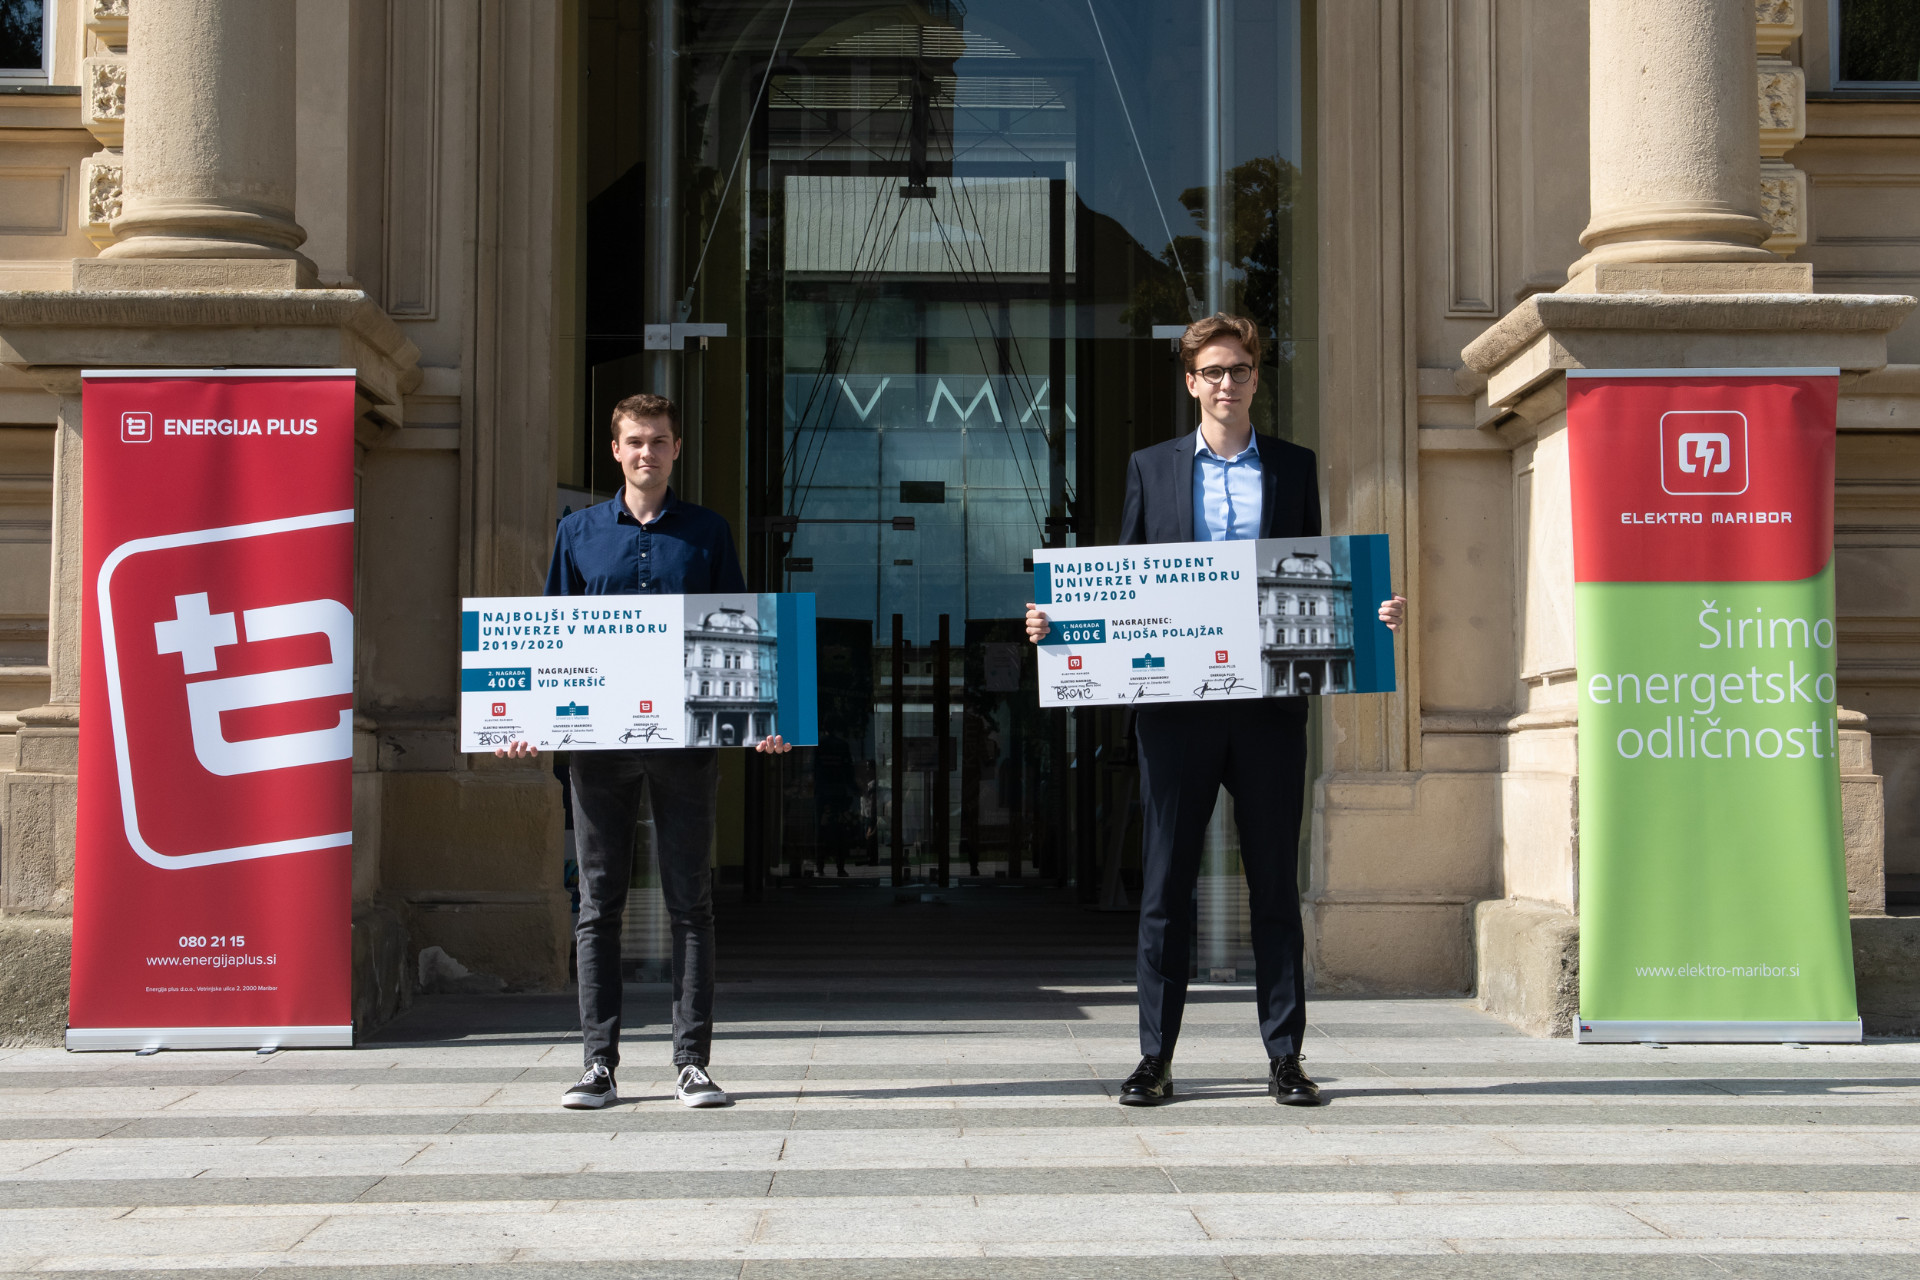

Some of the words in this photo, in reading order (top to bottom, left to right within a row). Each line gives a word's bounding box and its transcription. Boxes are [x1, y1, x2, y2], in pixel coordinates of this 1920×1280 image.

[164, 418, 262, 436] ENERGIJA
[267, 418, 318, 435] PLUS
[1621, 512, 1703, 524] ELEKTRO
[1711, 511, 1793, 524] MARIBOR
[1054, 558, 1136, 575] NAJBOLJŠI
[1143, 556, 1215, 570] ŠTUDENT
[1055, 574, 1133, 588] UNIVERZE
[1139, 574, 1148, 585] V
[1155, 570, 1241, 584] MARIBORU
[1055, 589, 1137, 603] 2019/2020
[483, 608, 565, 624] NAJBOLJŠI
[572, 608, 643, 621] ŠTUDENT
[1111, 617, 1173, 627] NAGRAJENEC:
[483, 625, 560, 637] UNIVERZE
[567, 625, 577, 635] V
[583, 623, 668, 635] MARIBORU
[1069, 622, 1100, 630] NAGRADA
[1698, 599, 1834, 649] Širimo
[1062, 629, 1101, 642] 600€
[1112, 627, 1158, 641] ALJOŠA
[1162, 625, 1224, 639] POLAJŽAR
[482, 639, 564, 651] 2019/2020
[537, 667, 598, 675] NAGRAJENEC:
[488, 677, 526, 689] 400€
[537, 678, 559, 688] VID
[563, 675, 606, 688] KERŠIČ
[1587, 660, 1836, 715] energetsko
[1616, 715, 1835, 759] odličnost!
[178, 935, 207, 948] 080
[210, 935, 226, 948] 21
[229, 935, 245, 947] 15
[146, 953, 277, 968] www.energijaplus.si
[1635, 963, 1801, 978] www.elektro-maribor.si
